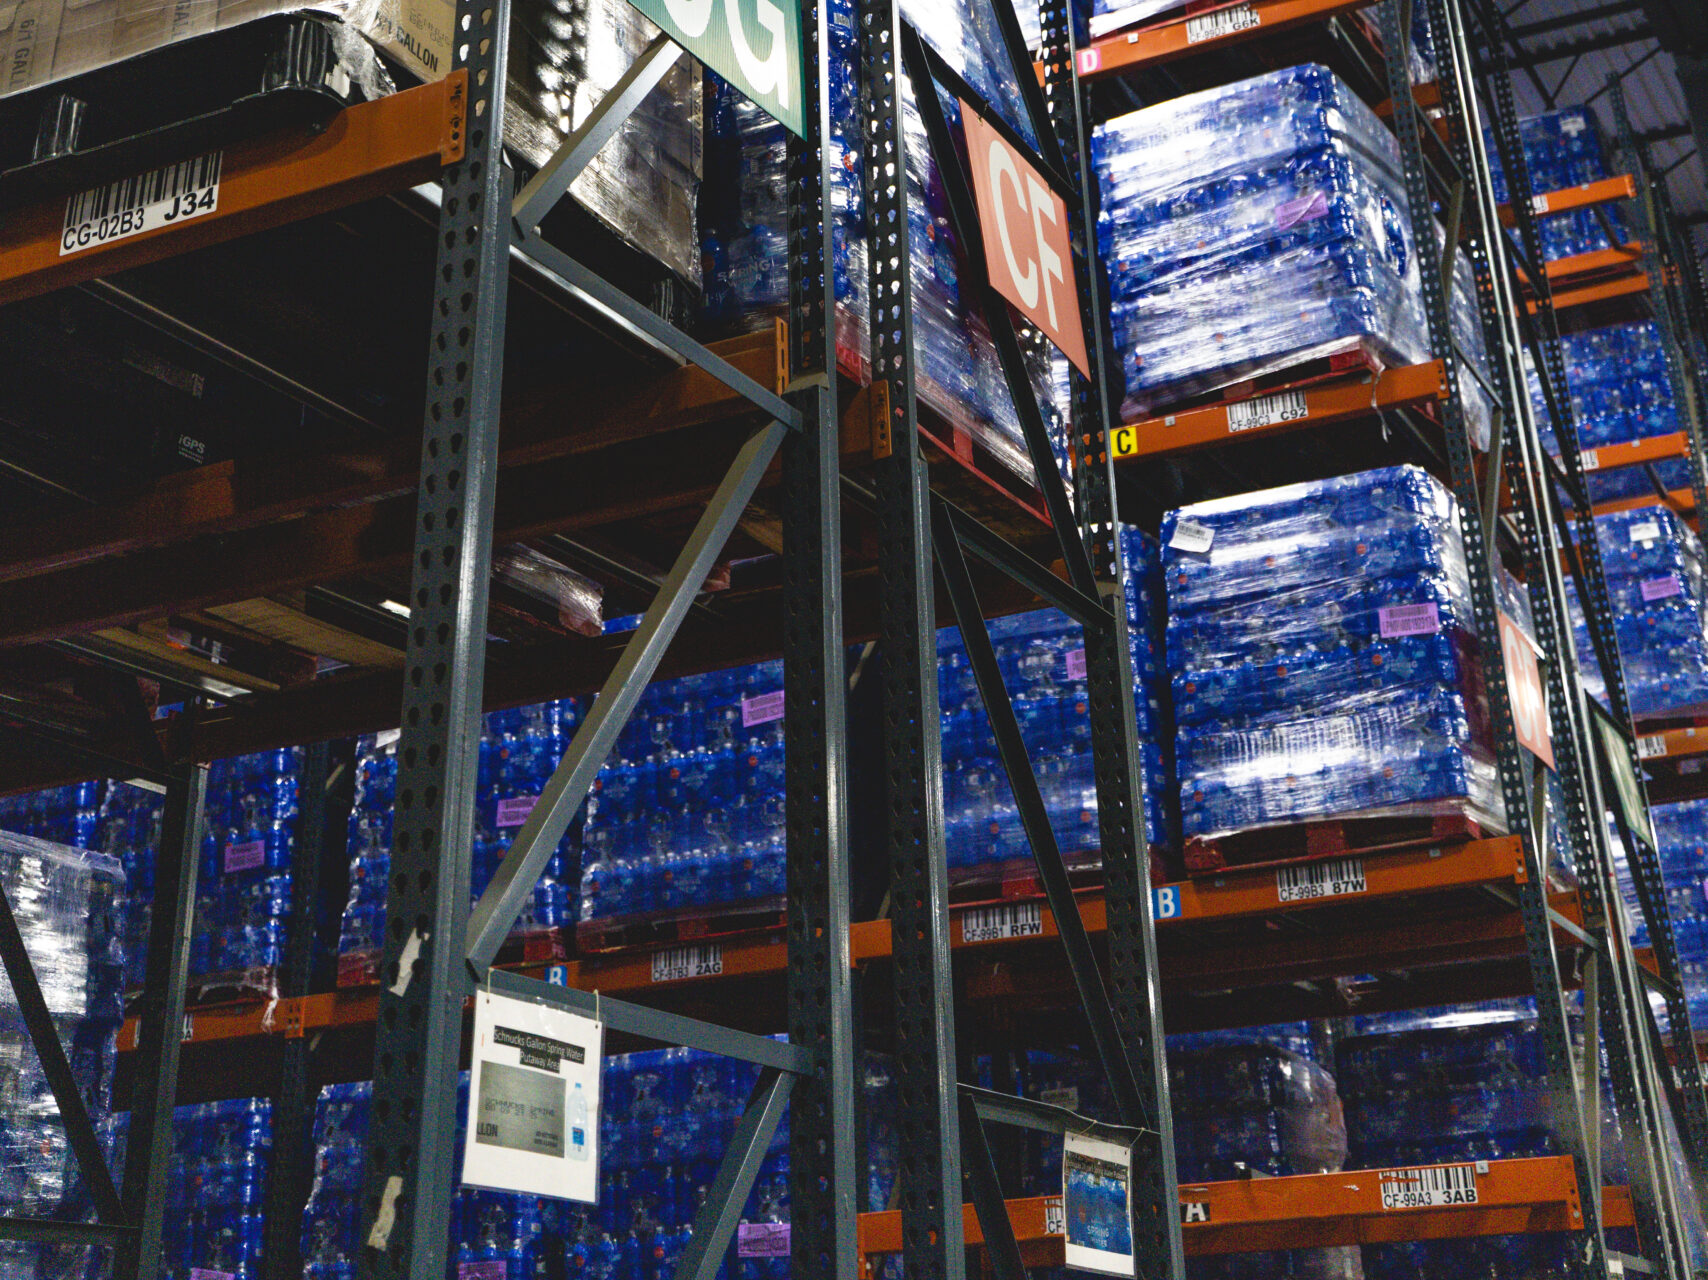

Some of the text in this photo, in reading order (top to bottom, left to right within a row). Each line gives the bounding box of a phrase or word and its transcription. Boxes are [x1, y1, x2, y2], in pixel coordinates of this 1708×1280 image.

[18, 18, 35, 42] 6/1
[396, 25, 439, 72] GALLON
[1081, 49, 1098, 73] D
[63, 187, 215, 250] CG-02B3 J34
[989, 139, 1064, 333] CF
[1230, 406, 1307, 432] CF-99C3 C92
[178, 434, 206, 454] iGPS
[1116, 429, 1132, 454] C
[1280, 878, 1365, 901] CF-99B3 87W
[1157, 887, 1176, 919] B
[1010, 922, 1041, 936] RFW
[695, 962, 722, 976] 2AG
[494, 1029, 584, 1061] Schnucks Gallon Spring Water
[520, 1050, 560, 1071] Putaway Area
[1383, 1188, 1477, 1208] CF-99A3 3AB
[1185, 1202, 1207, 1223] A
